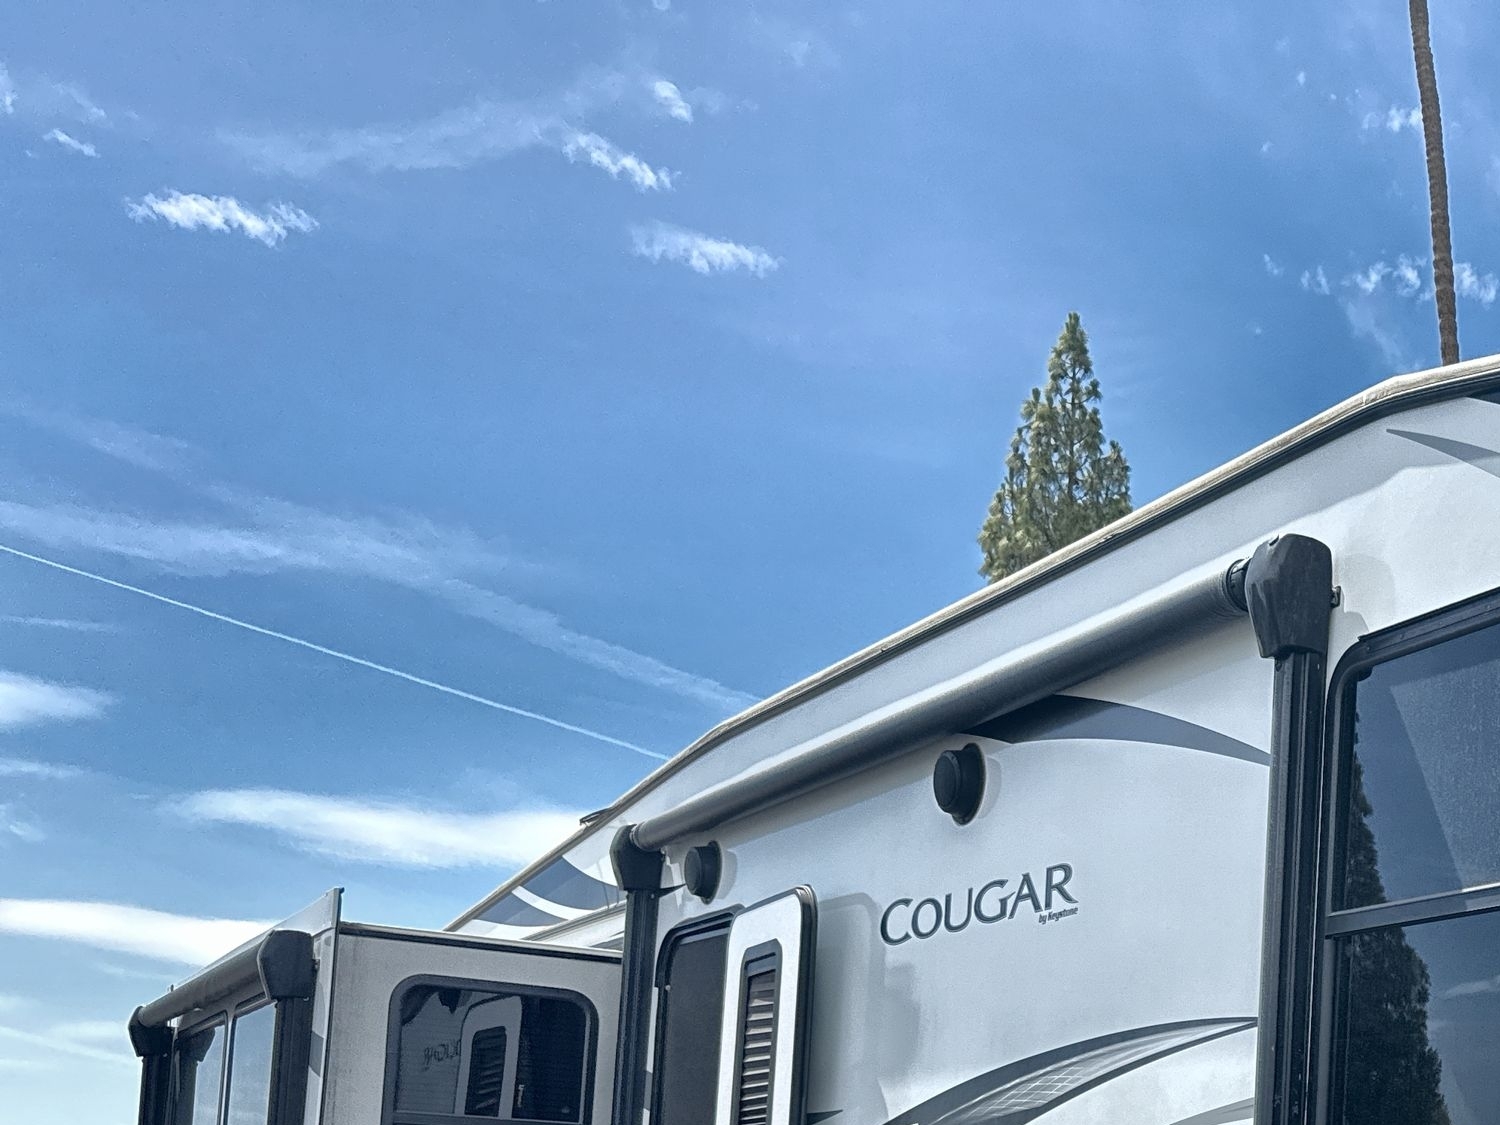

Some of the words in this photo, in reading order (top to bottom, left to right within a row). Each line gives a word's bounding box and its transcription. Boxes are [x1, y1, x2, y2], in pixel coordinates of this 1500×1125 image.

[880, 862, 1079, 945] COUGAR
[1038, 913, 1048, 925] by
[1048, 906, 1079, 922] Keystone
